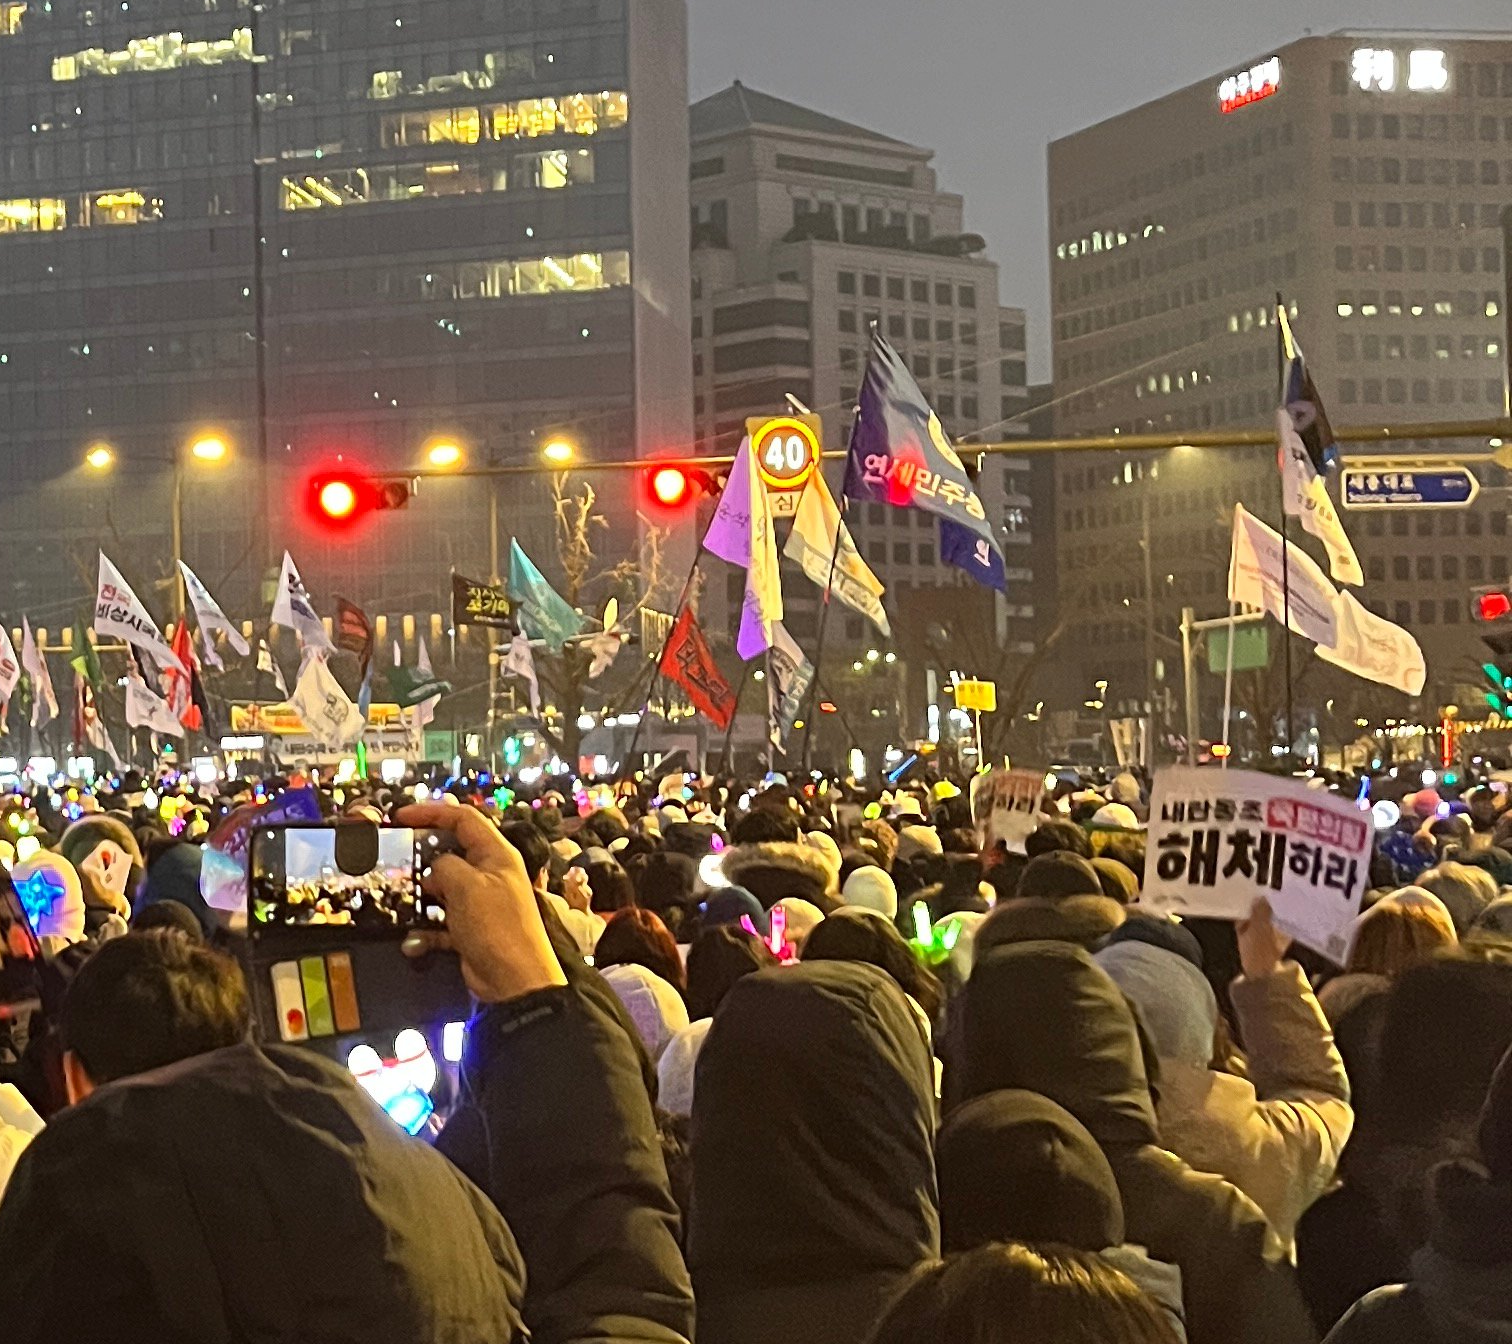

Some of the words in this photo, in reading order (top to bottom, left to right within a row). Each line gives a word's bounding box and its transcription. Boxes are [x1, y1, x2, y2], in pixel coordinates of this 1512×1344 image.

[765, 435, 805, 471] 40
[1161, 797, 1264, 823] 내란동조
[1156, 828, 1358, 900] 해체하라
